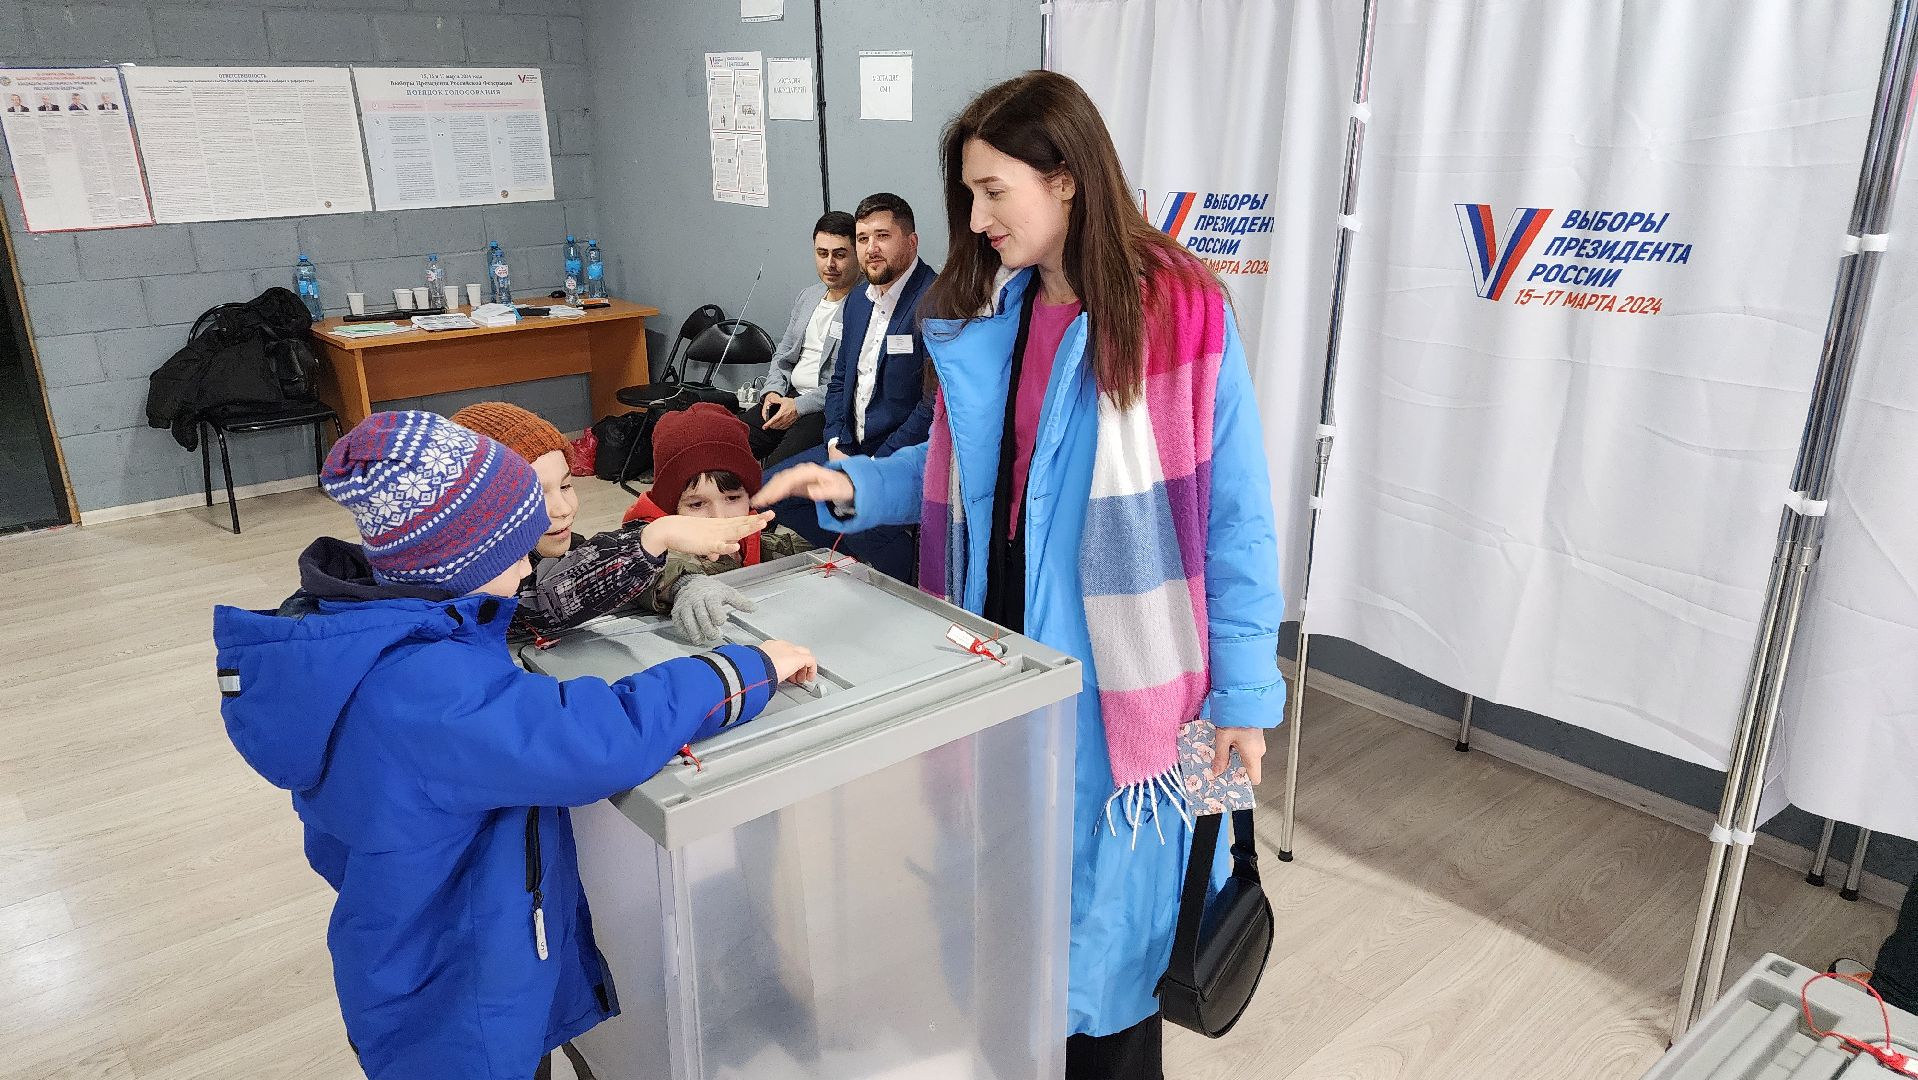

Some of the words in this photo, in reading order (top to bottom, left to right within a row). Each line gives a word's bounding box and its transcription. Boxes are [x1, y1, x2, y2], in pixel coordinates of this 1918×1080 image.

[1203, 192, 1269, 210] ВЫБОРЫ
[1561, 209, 1670, 234] ВЫБОРЫ
[1186, 236, 1241, 255] РОССИИ
[1543, 236, 1693, 265] ПРЕЗИДЕНТА
[1209, 259, 1240, 274] МАРТА
[1241, 259, 1269, 274] 2024
[1526, 263, 1623, 288] РОССИИ
[1562, 291, 1617, 313] МАРТА
[1617, 295, 1663, 315] 2024
